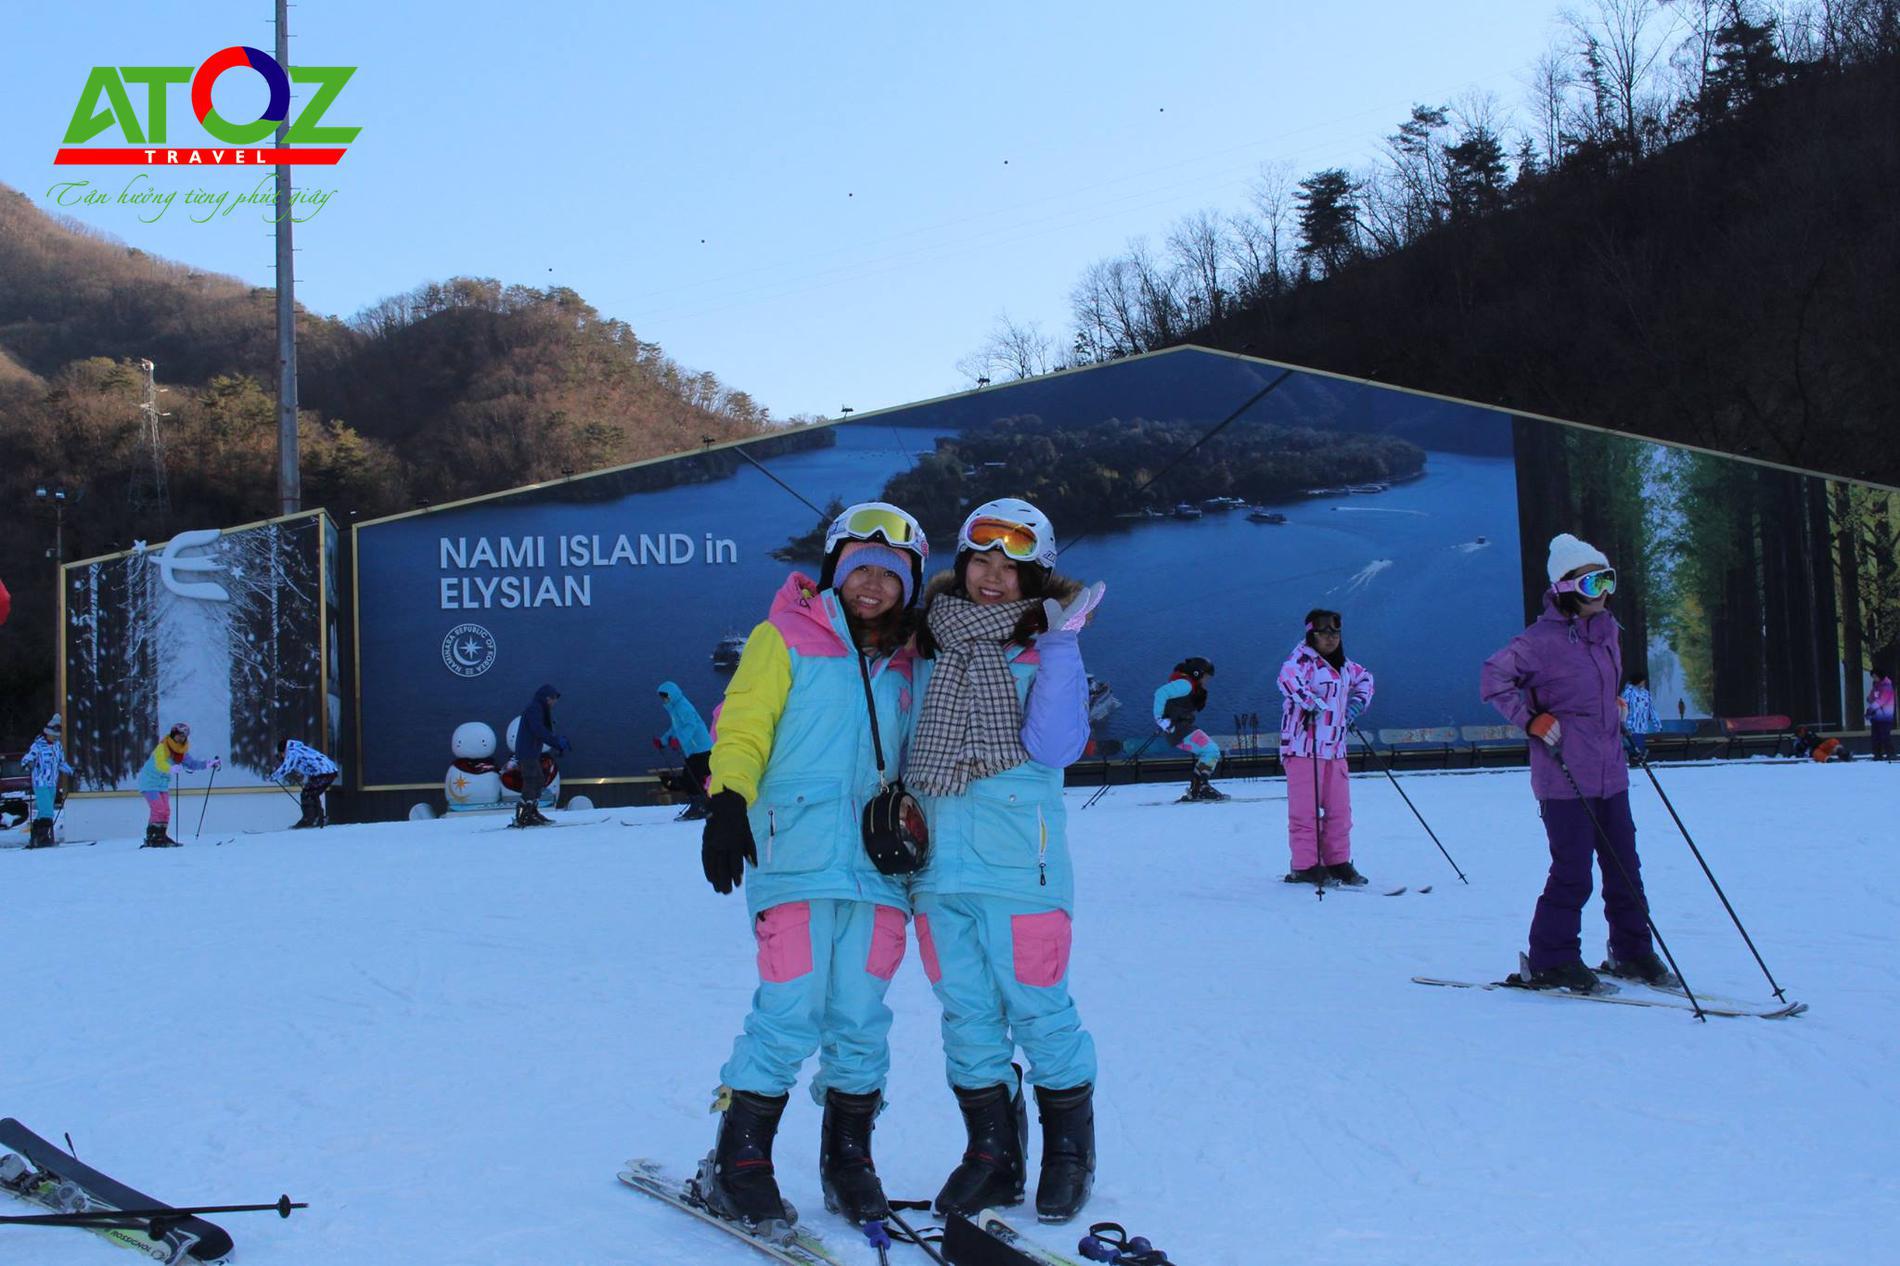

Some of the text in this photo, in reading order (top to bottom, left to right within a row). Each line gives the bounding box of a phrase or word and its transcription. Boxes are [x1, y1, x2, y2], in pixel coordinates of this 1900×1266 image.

[440, 533, 738, 569] NAMI ISLAND in
[441, 575, 591, 609] ELYSIAN
[454, 626, 488, 639] REPUBLIC
